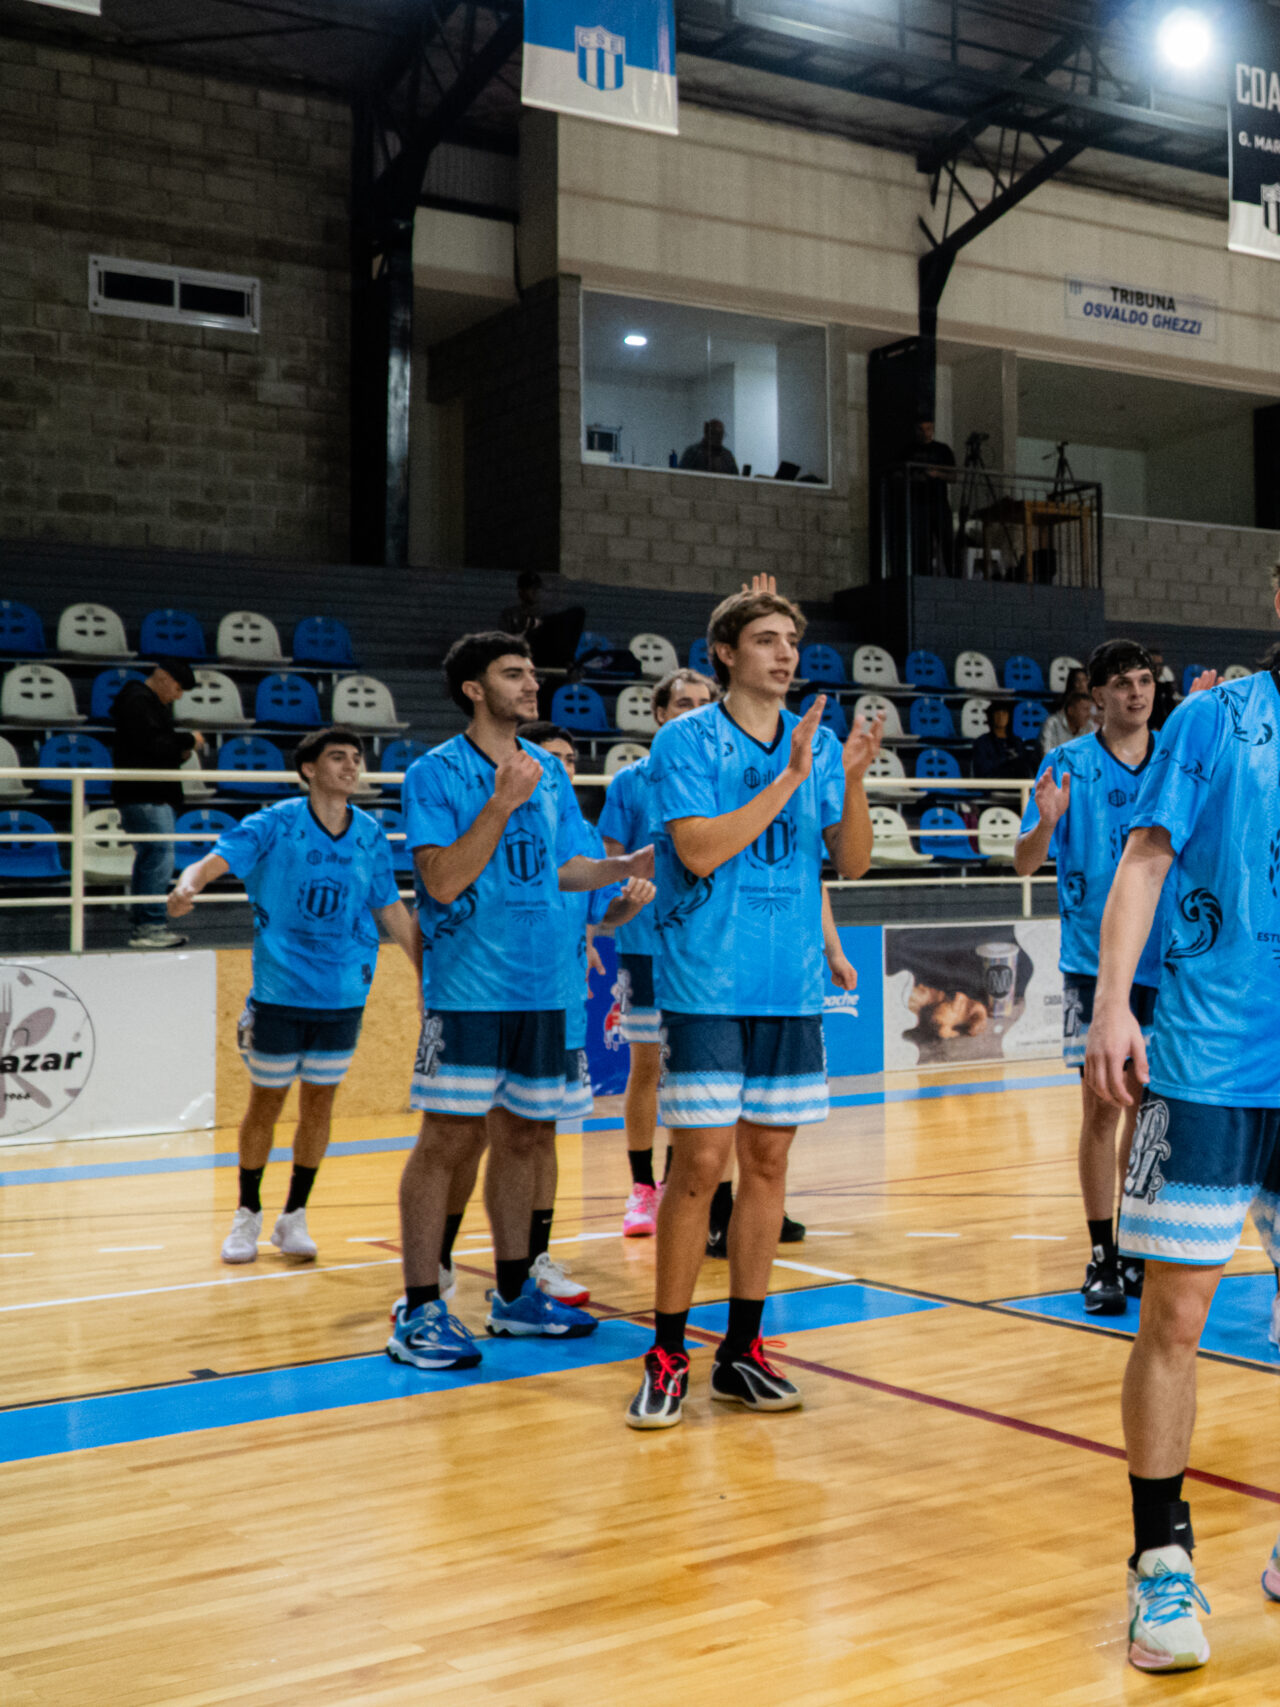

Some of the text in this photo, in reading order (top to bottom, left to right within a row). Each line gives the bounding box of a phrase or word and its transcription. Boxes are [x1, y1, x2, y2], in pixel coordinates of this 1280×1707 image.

[1238, 131, 1252, 147] G.
[1110, 286, 1176, 312] TRIBUNA
[1083, 301, 1203, 335] OSVALDO GHEZZI
